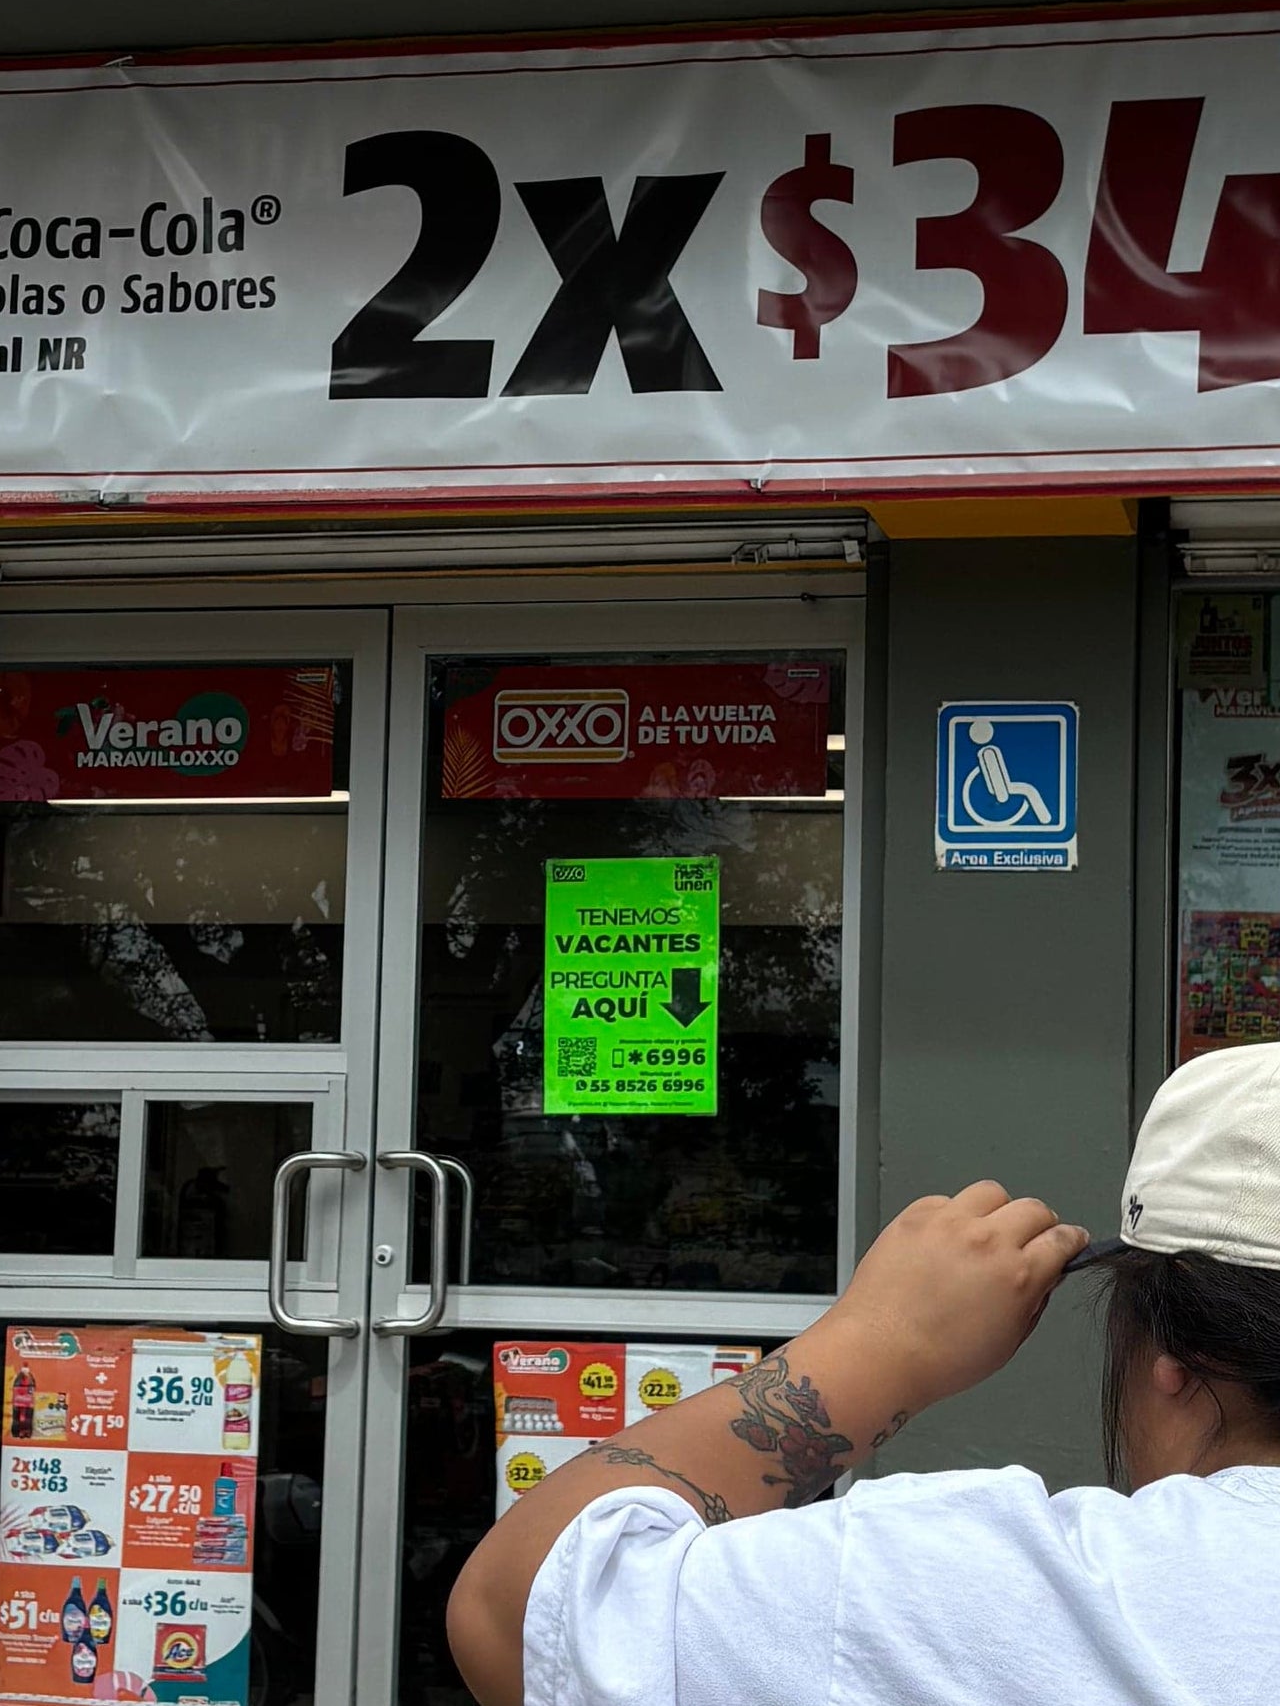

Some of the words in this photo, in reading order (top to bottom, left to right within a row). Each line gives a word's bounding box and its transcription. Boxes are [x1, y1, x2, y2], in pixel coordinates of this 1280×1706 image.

[81, 284, 106, 315] o
[120, 271, 277, 314] Sabores
[36, 336, 87, 372] NR
[639, 706, 655, 722] A
[661, 705, 690, 722] LA
[692, 704, 777, 722] VUELTA
[76, 702, 243, 750] Verano
[500, 702, 623, 750] OXXO
[638, 726, 670, 744] DE
[674, 725, 708, 744] TU
[713, 725, 777, 744] VIDA
[76, 749, 240, 768] MARAVILLOXXO
[993, 850, 1063, 865] Exclusiva
[576, 907, 681, 926] TENEMOS
[555, 933, 701, 953] VACANTES
[550, 970, 668, 988] PREGUNTA
[571, 990, 649, 1023] AQUÍ
[589, 1079, 611, 1092] 55
[615, 1079, 658, 1092] 8526
[662, 1078, 705, 1092] 6996
[143, 1590, 187, 1617] $36
[0, 1600, 38, 1630] $51
